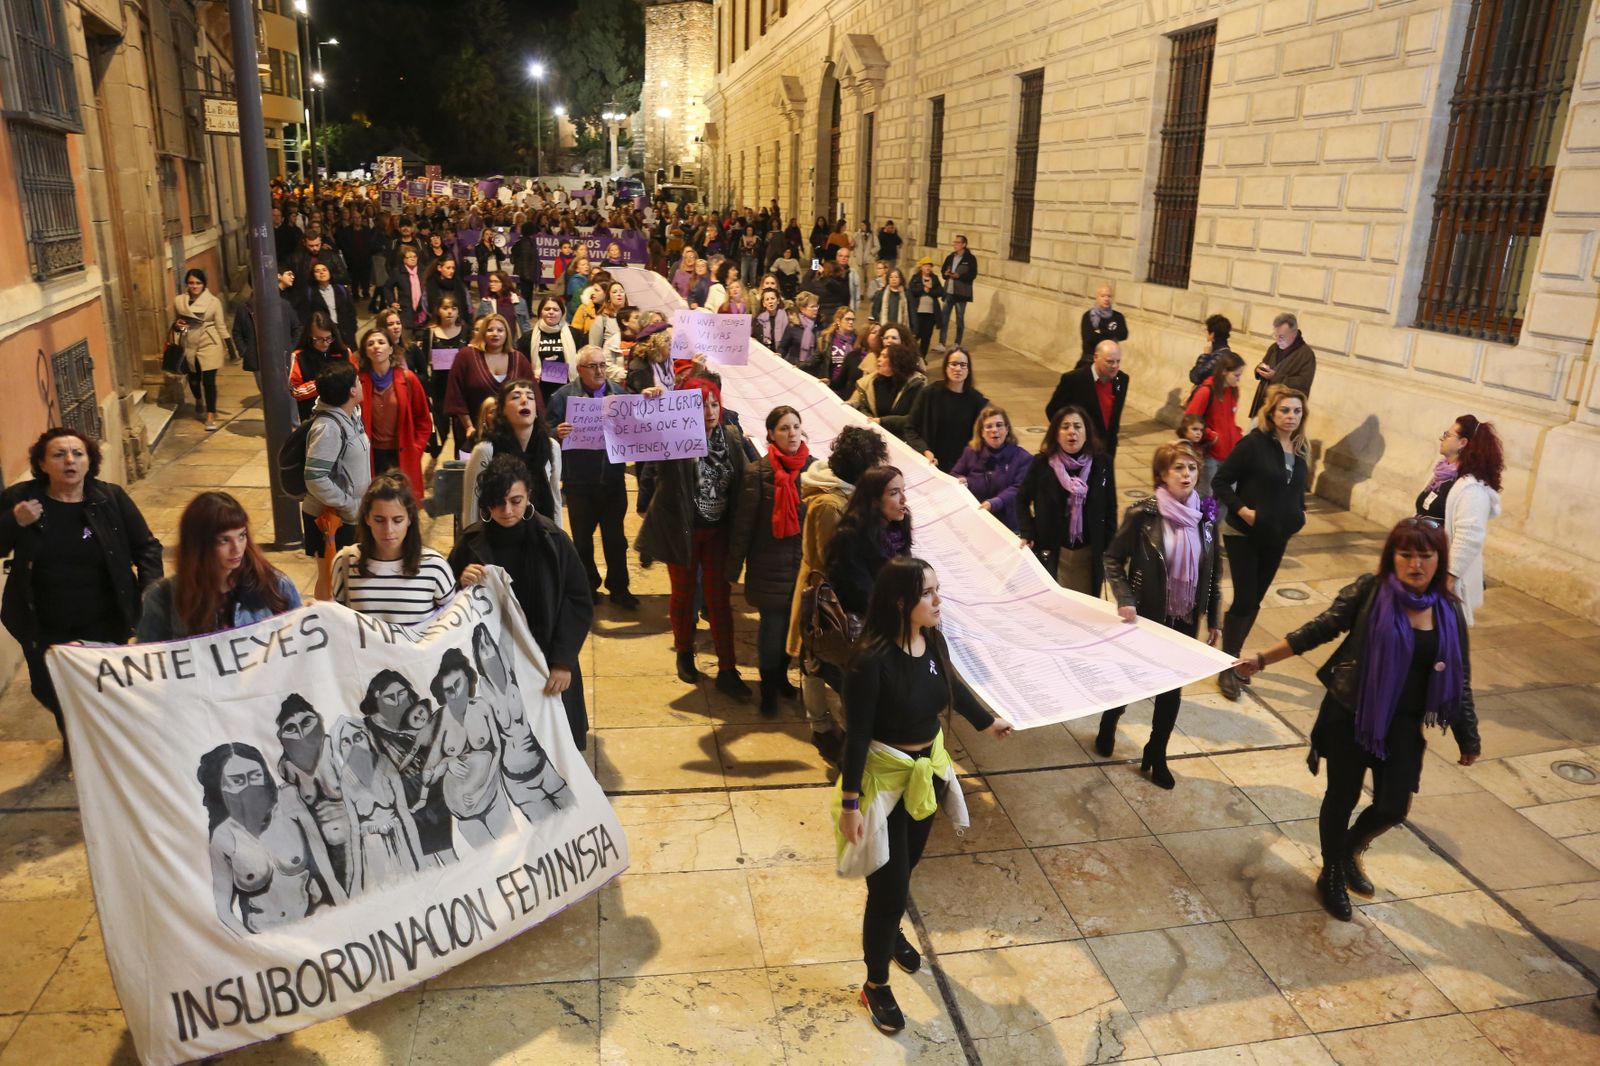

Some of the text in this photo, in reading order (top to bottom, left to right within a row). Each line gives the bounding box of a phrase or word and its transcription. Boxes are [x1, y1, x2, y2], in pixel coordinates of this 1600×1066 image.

[535, 237, 560, 247] UNA
[572, 402, 586, 413] TE
[607, 398, 655, 419] SOMOS
[675, 393, 703, 410] GRITO
[615, 416, 698, 436] DE LAS QUE YA
[611, 438, 705, 457] NO TIENEN VOZ
[96, 648, 196, 693] ANTE
[209, 613, 329, 677] LEYES
[170, 823, 620, 1042] INSUBORDINACION FEMINISTA
